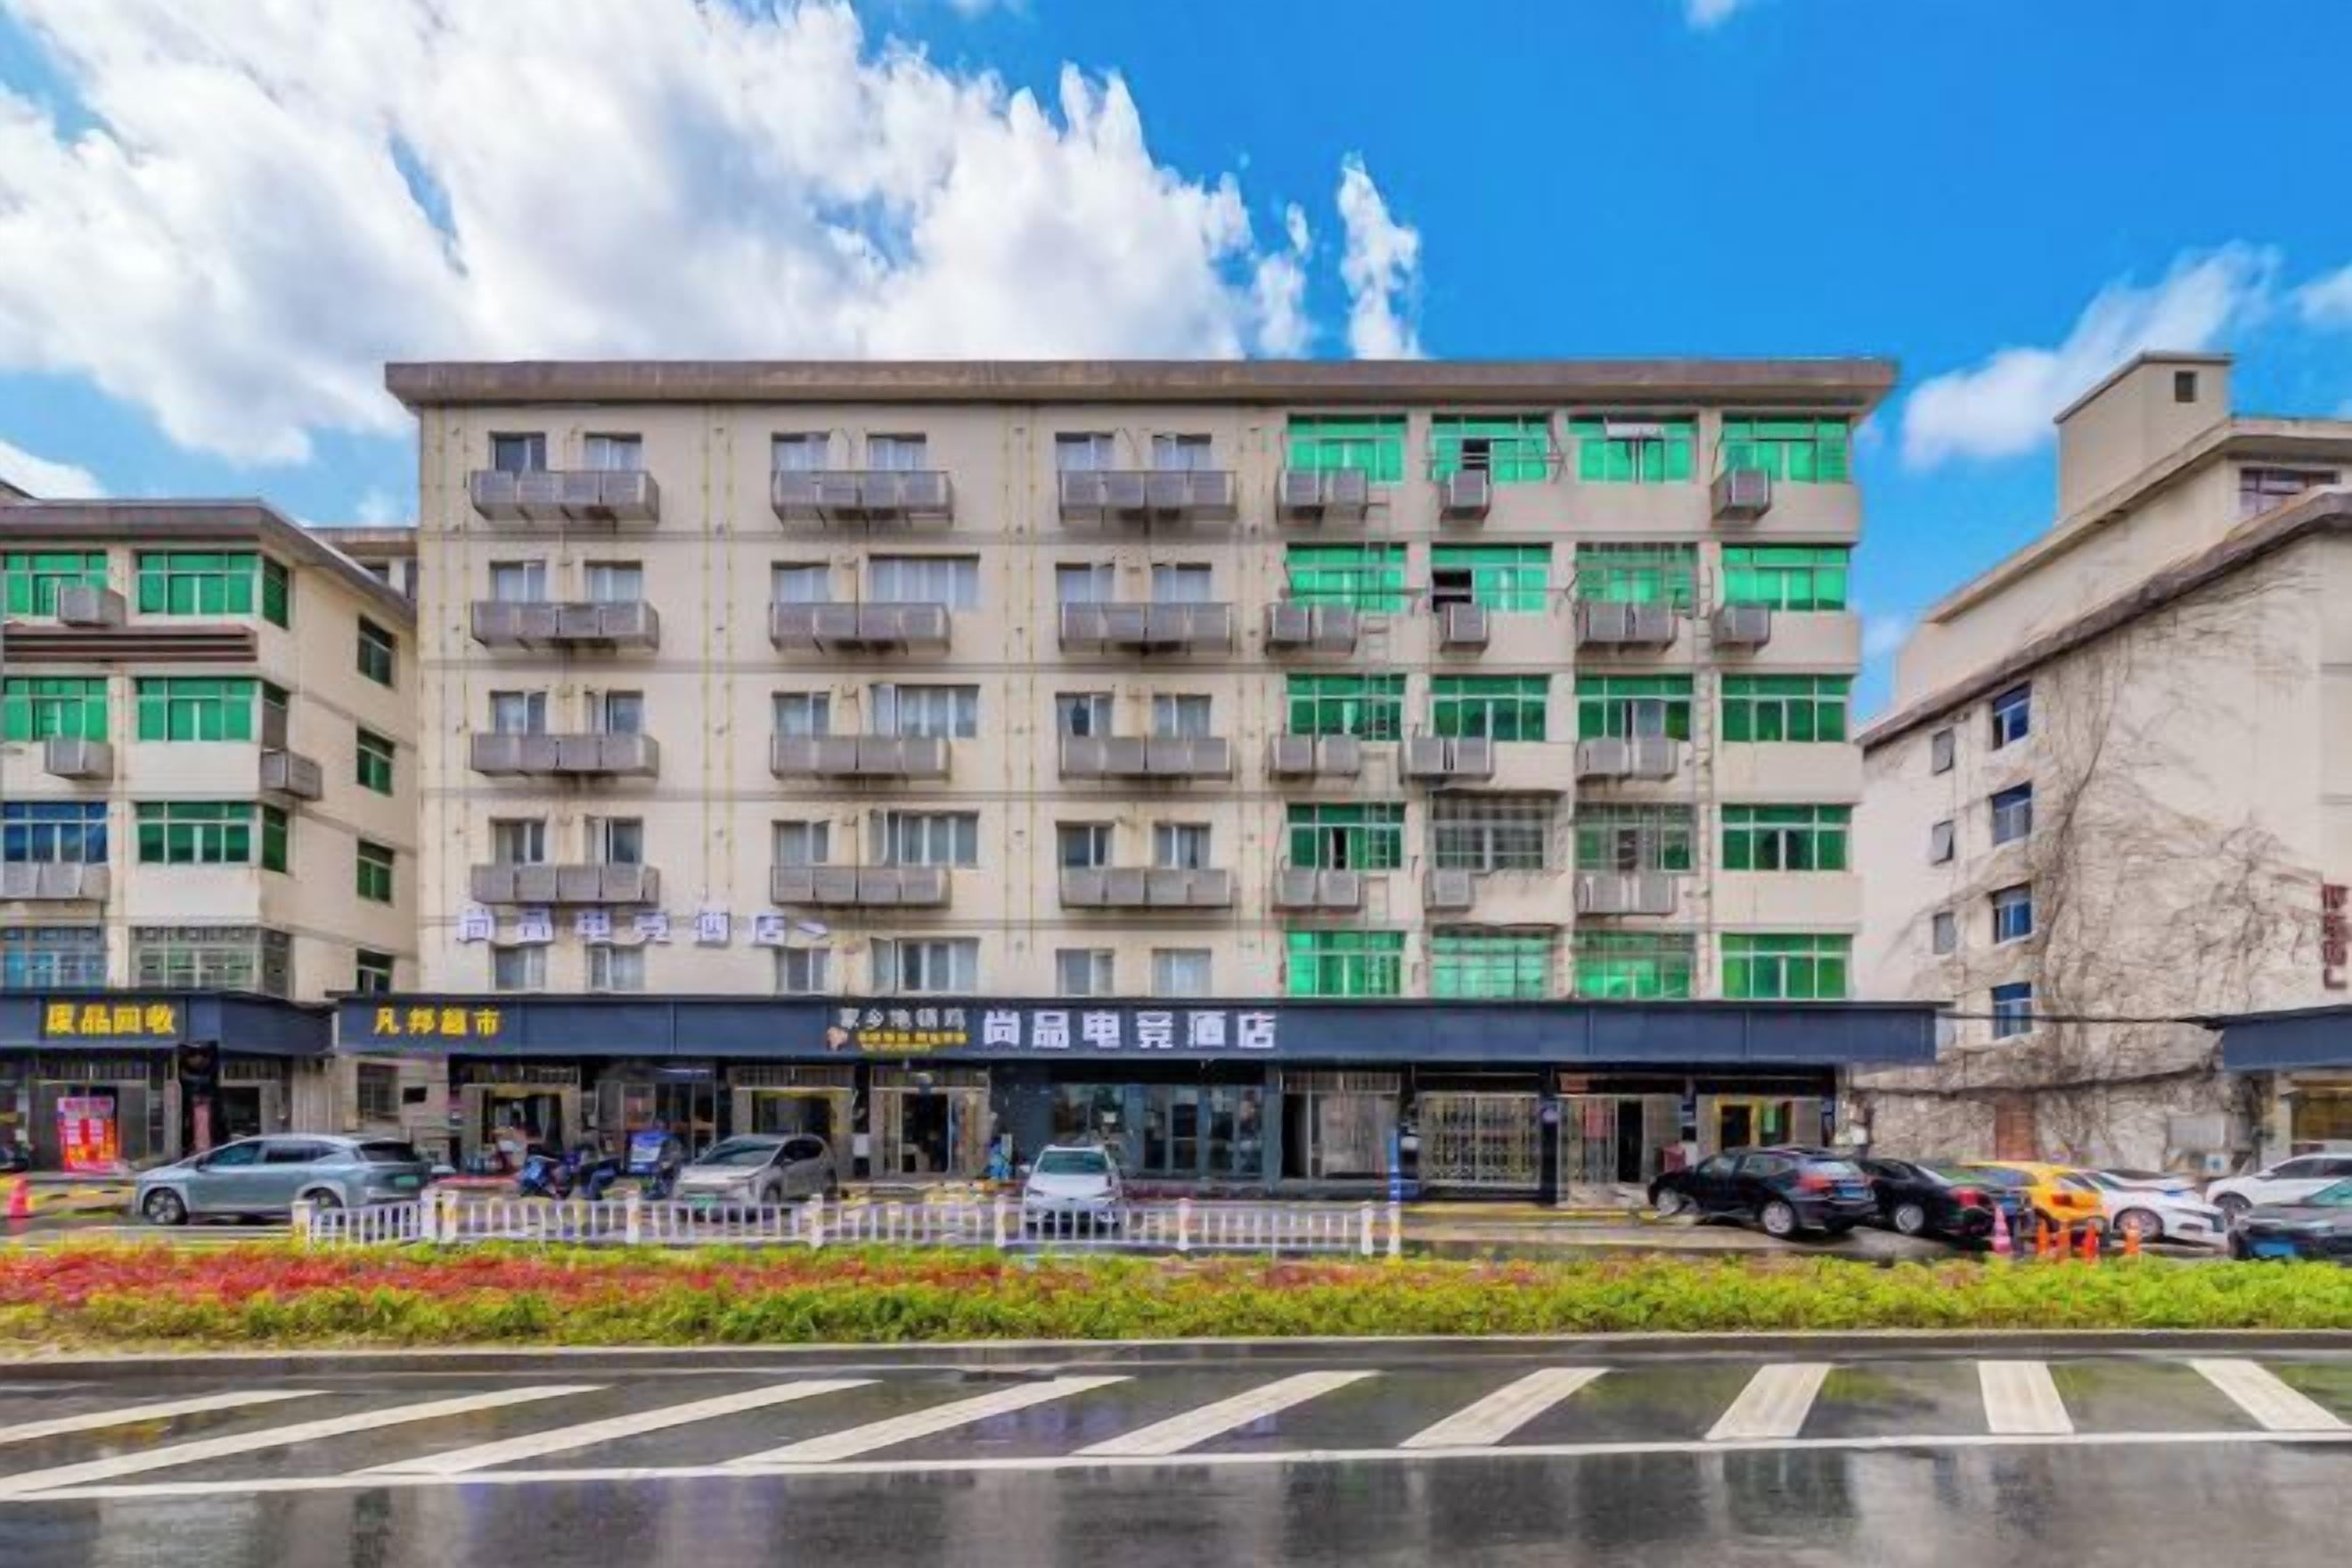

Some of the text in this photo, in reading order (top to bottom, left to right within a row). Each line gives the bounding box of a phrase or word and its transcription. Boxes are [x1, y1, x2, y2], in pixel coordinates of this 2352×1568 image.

[983, 1009, 1276, 1049] 尚品电竞酒店
